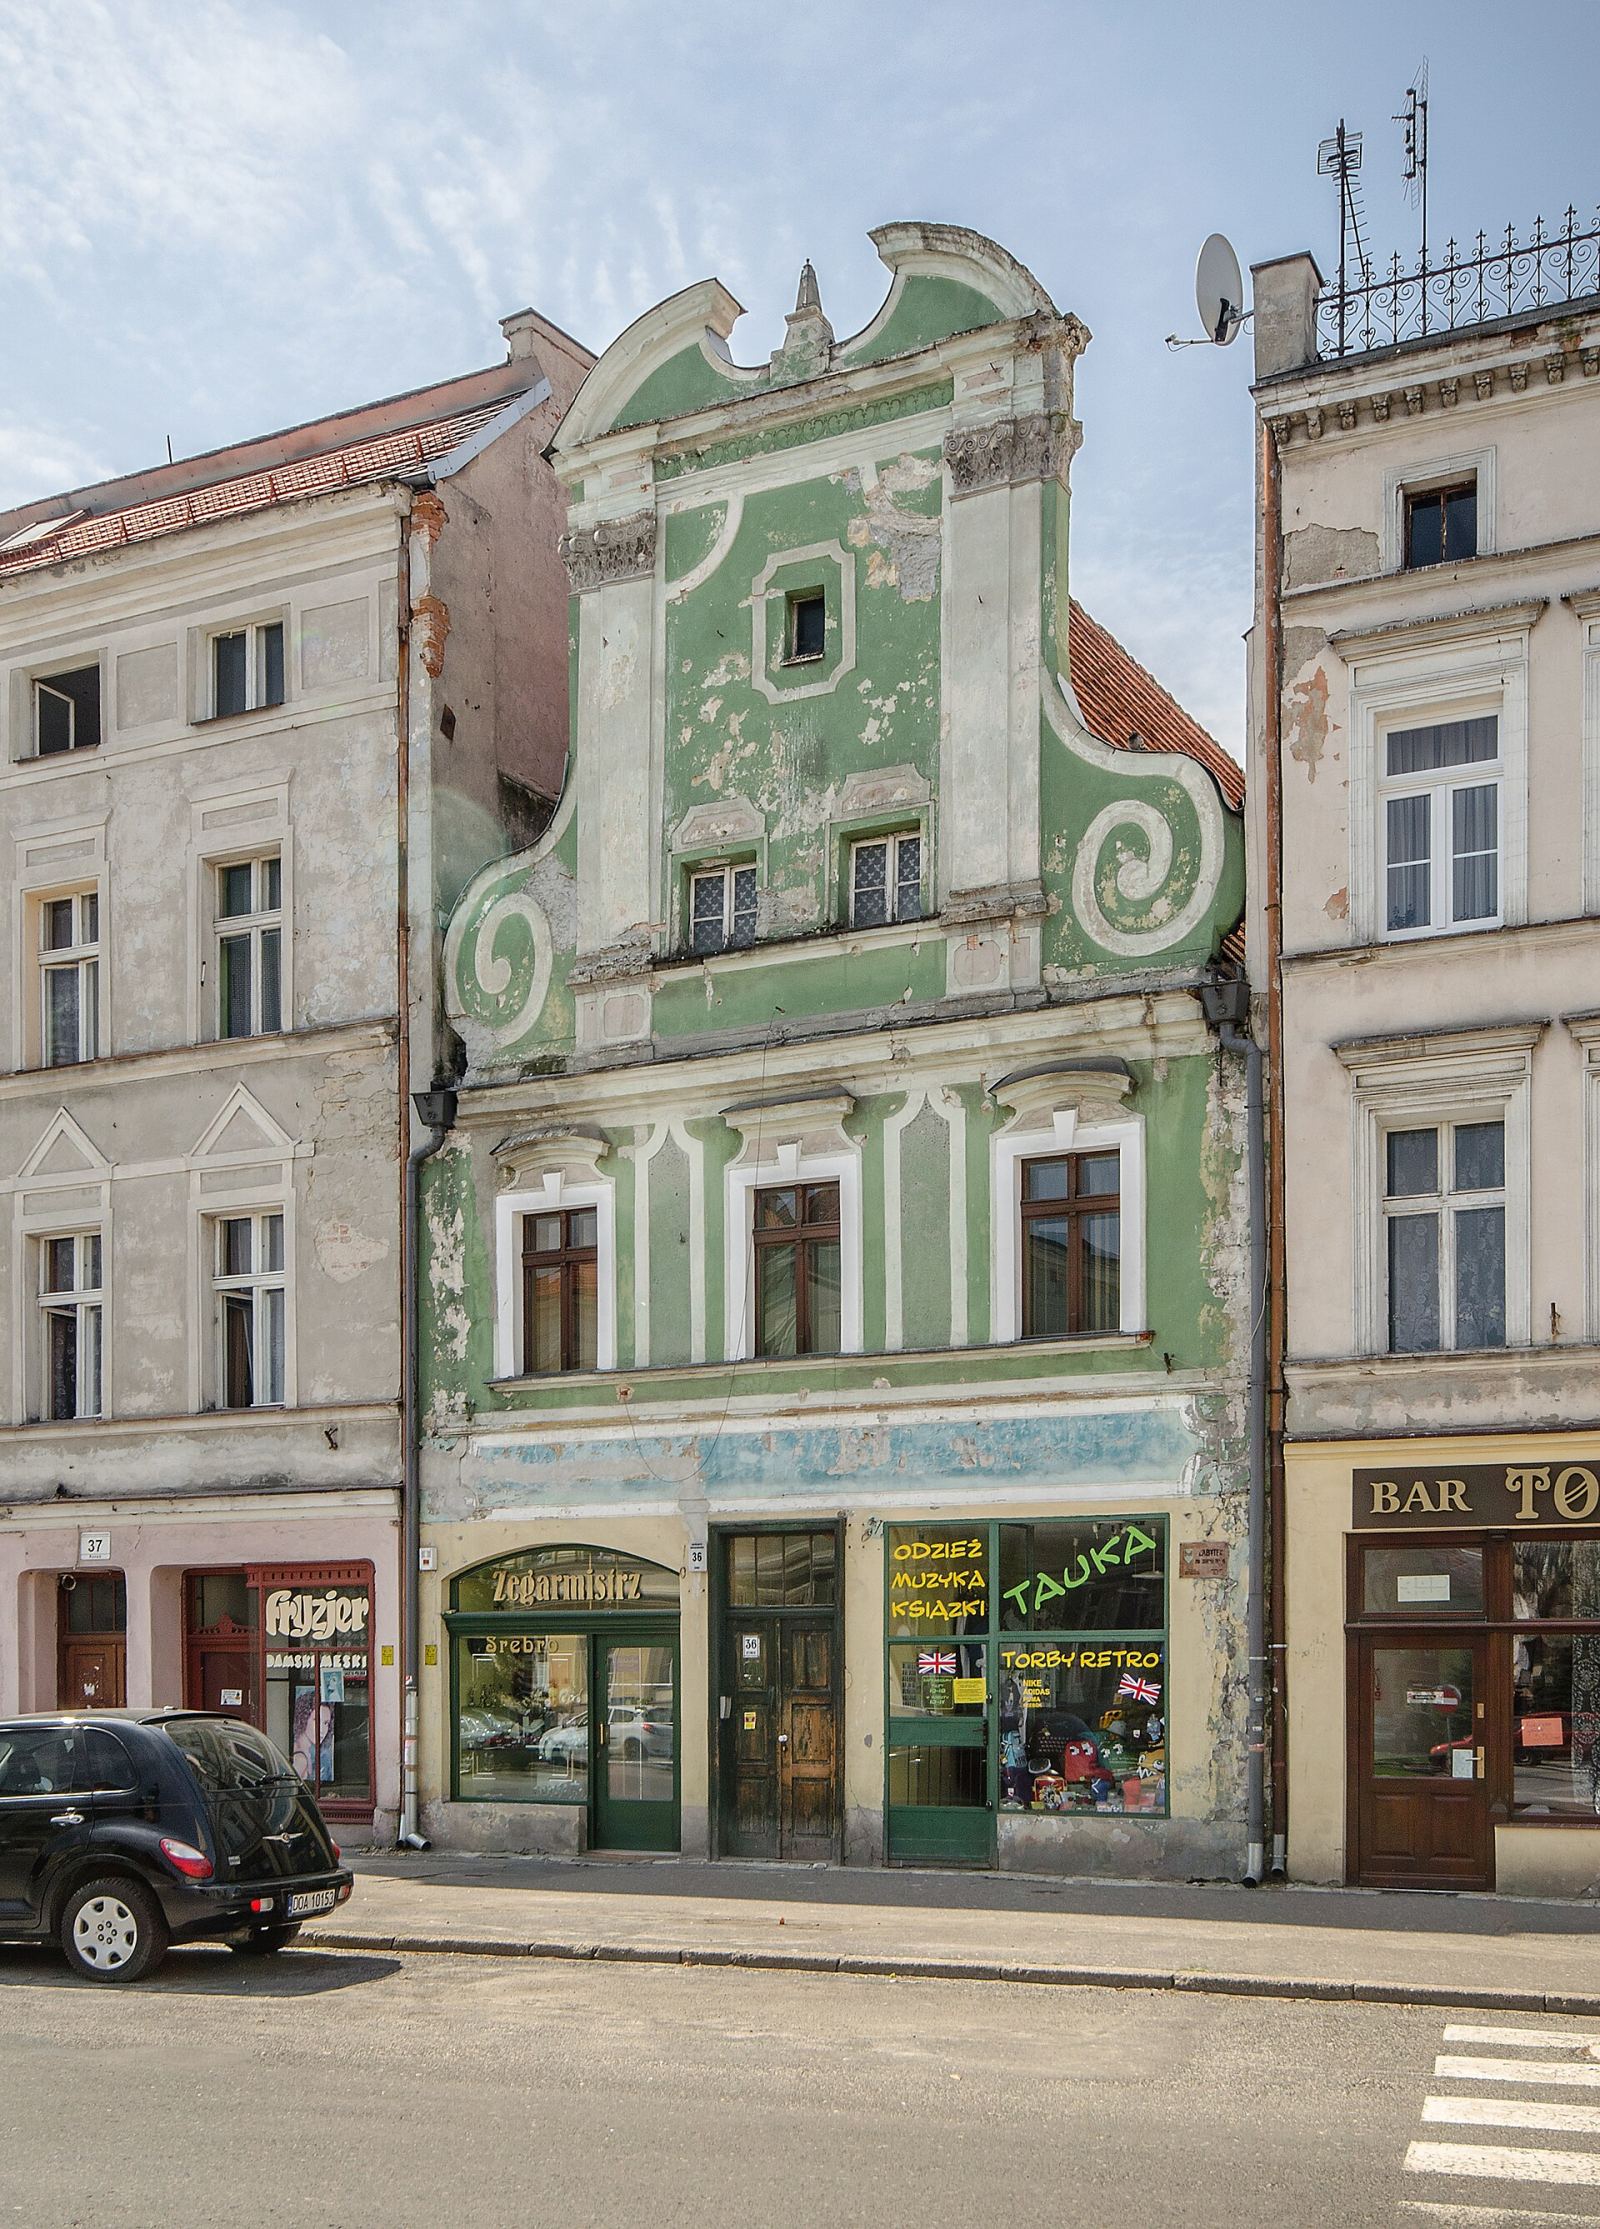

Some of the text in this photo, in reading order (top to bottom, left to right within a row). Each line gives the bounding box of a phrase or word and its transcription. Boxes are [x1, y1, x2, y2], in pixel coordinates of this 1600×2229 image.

[1370, 1480, 1473, 1514] BAR
[88, 1539, 103, 1552] 37
[894, 1539, 982, 1560] ODZIEŻ
[692, 1552, 702, 1562] 36
[1003, 1525, 1157, 1615] TAUKA
[493, 1569, 642, 1606] Zegarmistrz
[891, 1570, 985, 1590] MUZYKA
[485, 1635, 559, 1653] Srebro
[745, 1639, 757, 1650] 36
[266, 1654, 316, 1669] DAMSKI
[1001, 1650, 1160, 1668] TORBY RETRO
[1023, 1679, 1042, 1687] NIKE
[1023, 1688, 1051, 1696] ADIDAS
[292, 1891, 335, 1911] DOA 10153
